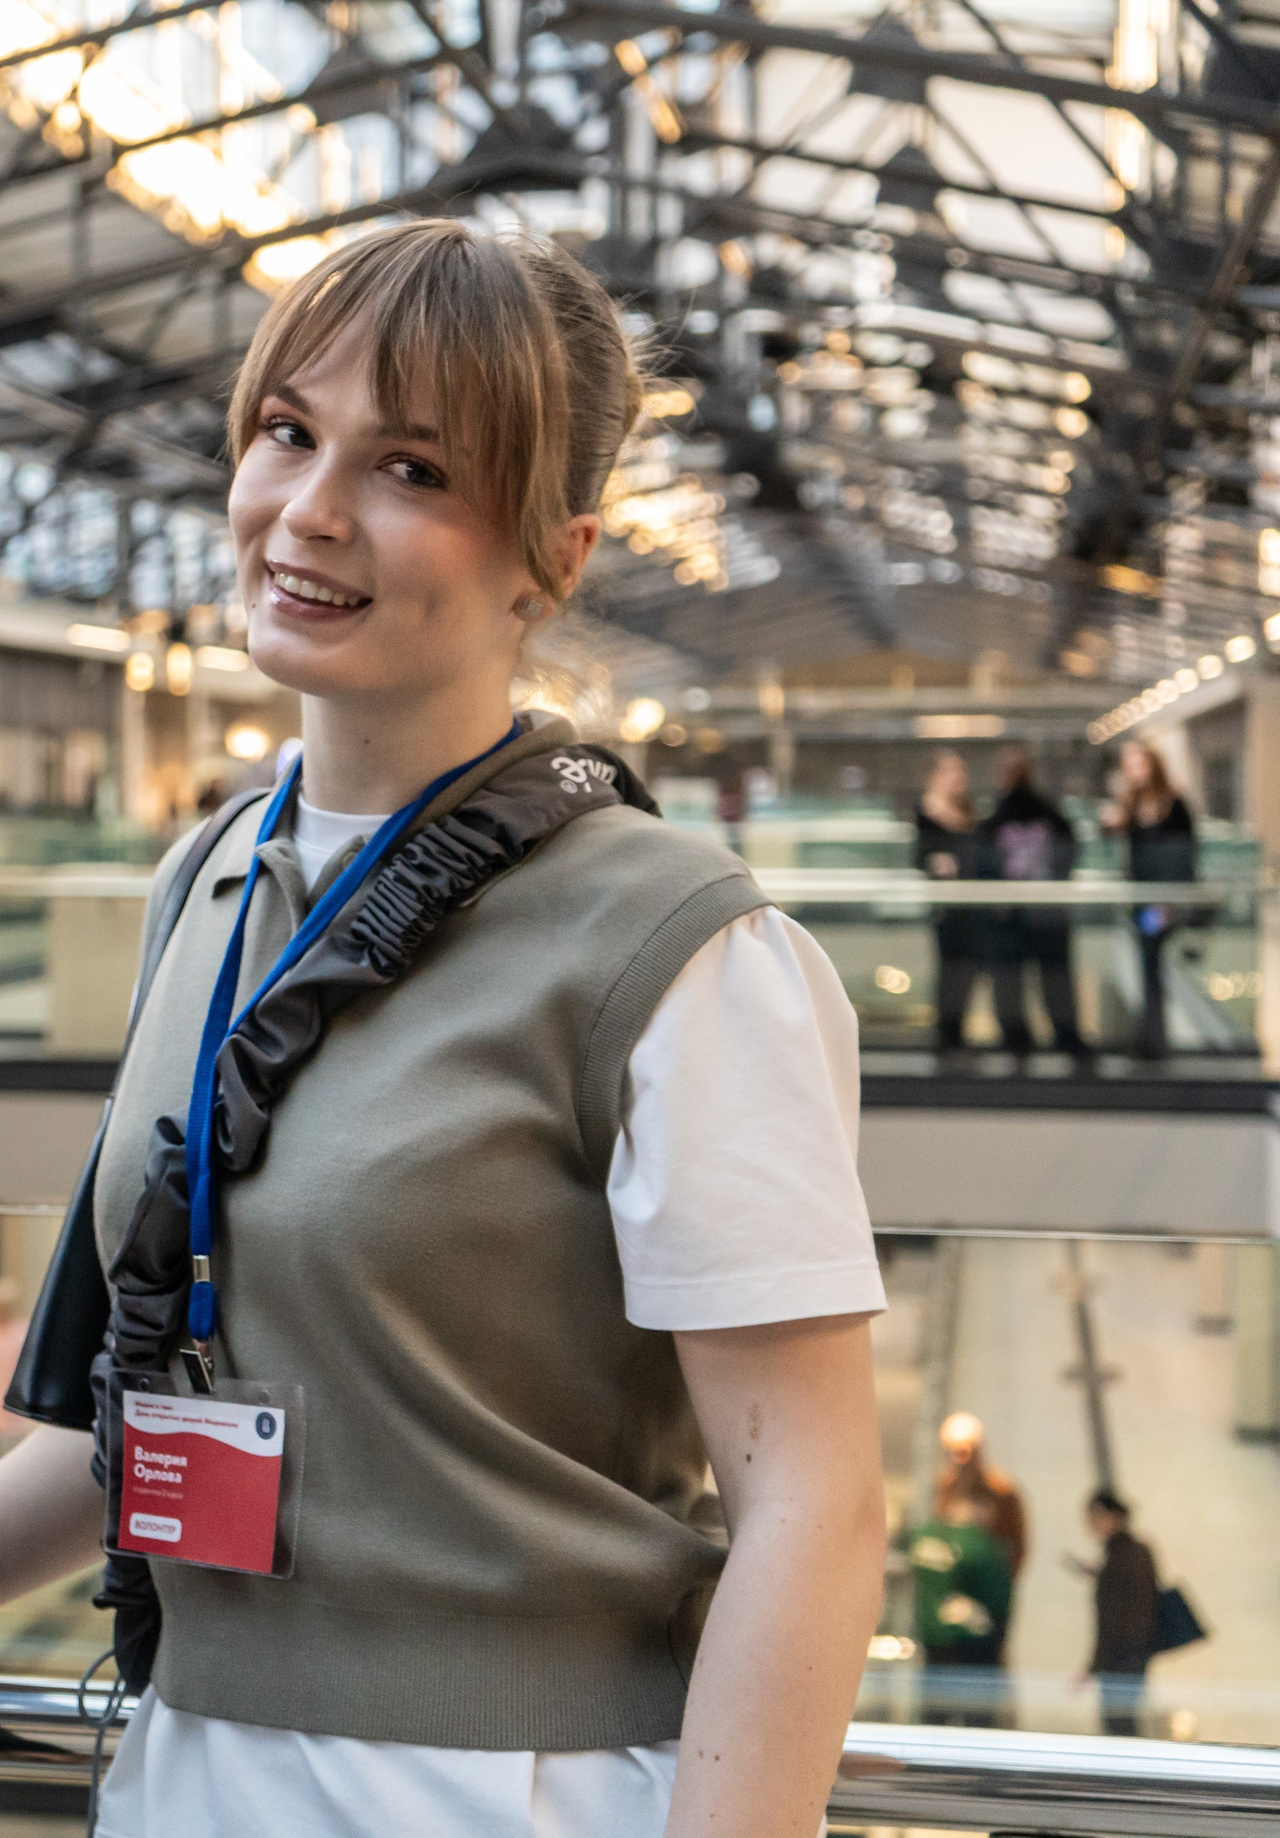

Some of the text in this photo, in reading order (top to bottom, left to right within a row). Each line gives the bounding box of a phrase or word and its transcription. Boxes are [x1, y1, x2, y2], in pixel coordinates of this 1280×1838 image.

[134, 1445, 188, 1469] Валерия
[133, 1463, 183, 1484] Орлова
[134, 1519, 177, 1534] ВОЛОНТЕР
